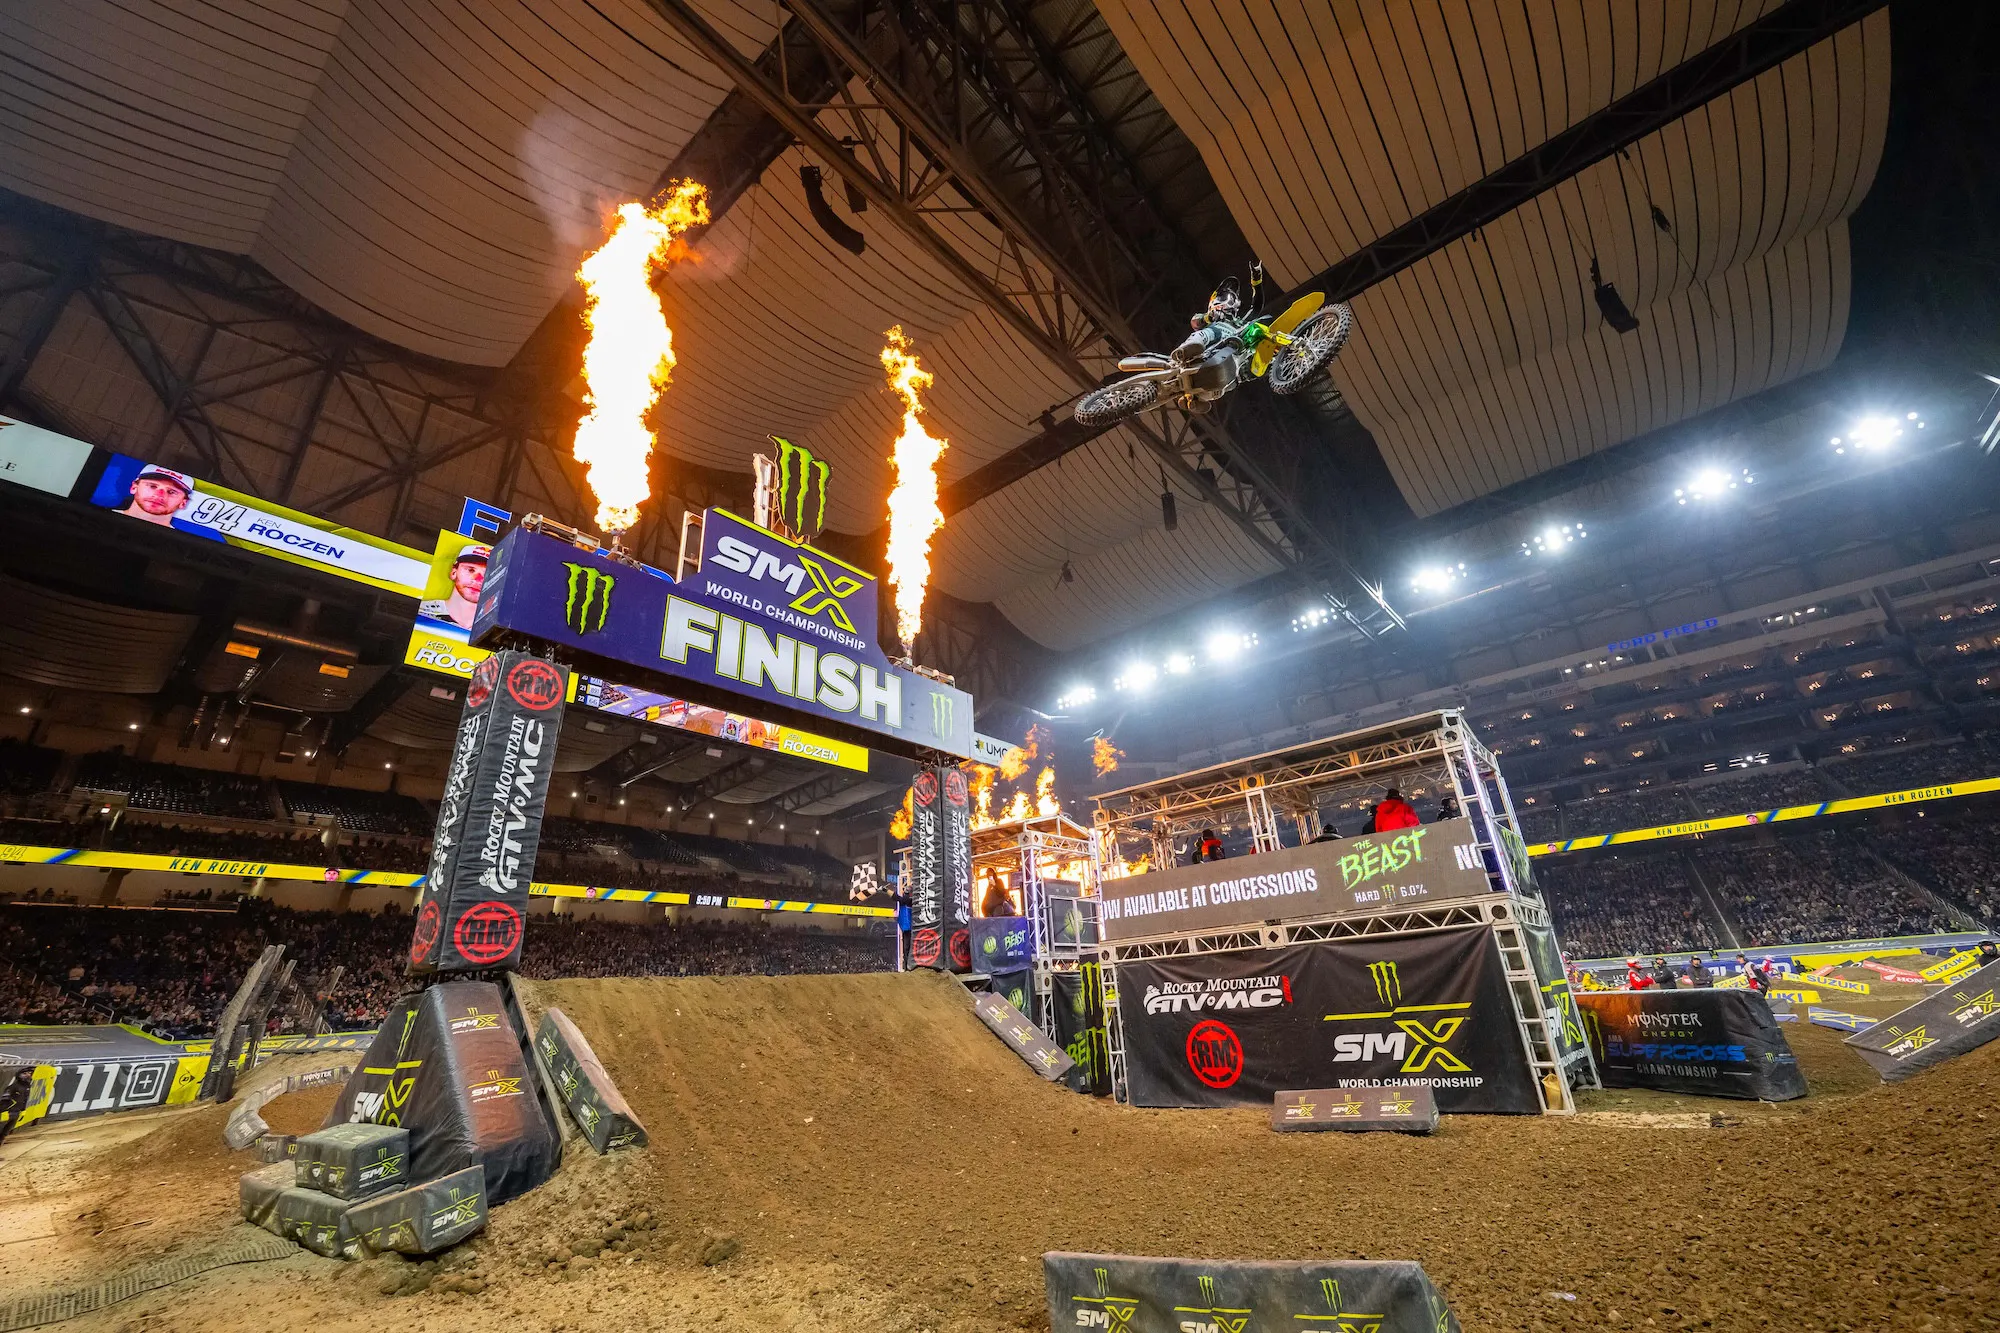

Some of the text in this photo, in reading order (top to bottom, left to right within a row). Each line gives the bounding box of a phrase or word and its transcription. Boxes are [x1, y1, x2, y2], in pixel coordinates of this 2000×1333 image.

[191, 498, 247, 532] 94
[257, 517, 282, 529] KEN
[248, 523, 345, 559] ROCZEN
[709, 535, 864, 635] SMX
[706, 581, 866, 651] WORLD CHAMPIONSHIP
[1607, 617, 1719, 653] FORD FIELD
[426, 640, 453, 653] KEN
[660, 594, 902, 729] FINISH
[783, 739, 839, 762] ROCZEN
[481, 714, 526, 863] ROCKY MOUNTAIN
[1885, 786, 1953, 804] KEN ROCZEN
[951, 811, 960, 868] MOUNTAIN
[1656, 823, 1710, 836] KEN ROCZEN
[918, 812, 926, 868] MOUNTAIN
[1352, 838, 1374, 851] THE
[1, 845, 27, 860] 94
[1336, 827, 1428, 892] BEAST
[169, 858, 268, 876] KEN ROCZEN
[711, 895, 723, 907] PM
[1124, 887, 1190, 918] AVAILABLE
[1192, 884, 1208, 908] AT
[1209, 867, 1319, 905] CONCESSIONS
[1354, 883, 1429, 903] HARD 6.0%
[1925, 954, 1970, 977] SUZUKI
[1162, 975, 1281, 994] ROCKY MOUNTAIN
[1806, 973, 1866, 994] SUZUKI
[1955, 992, 2000, 1024] SMX
[451, 1016, 498, 1029] SMX
[1607, 1034, 1623, 1043] AMA
[1642, 1030, 1694, 1038] ENERGY
[1888, 1028, 1936, 1057] SMX
[1332, 1016, 1473, 1073] SMX
[1607, 1043, 1746, 1062] SUPERCROSS
[302, 1070, 332, 1082] MONSTER
[1636, 1063, 1718, 1079] CHAMPIONSHIP
[471, 1080, 521, 1097] SMX
[1338, 1076, 1484, 1089] WORLD CHAMPIONSHIP
[349, 1077, 416, 1128] SMX
[1285, 1106, 1315, 1118] SMX
[1330, 1104, 1363, 1116] SMX
[1379, 1102, 1415, 1115] SMX
[358, 1157, 401, 1183] SMX
[431, 1198, 479, 1231] SMX
